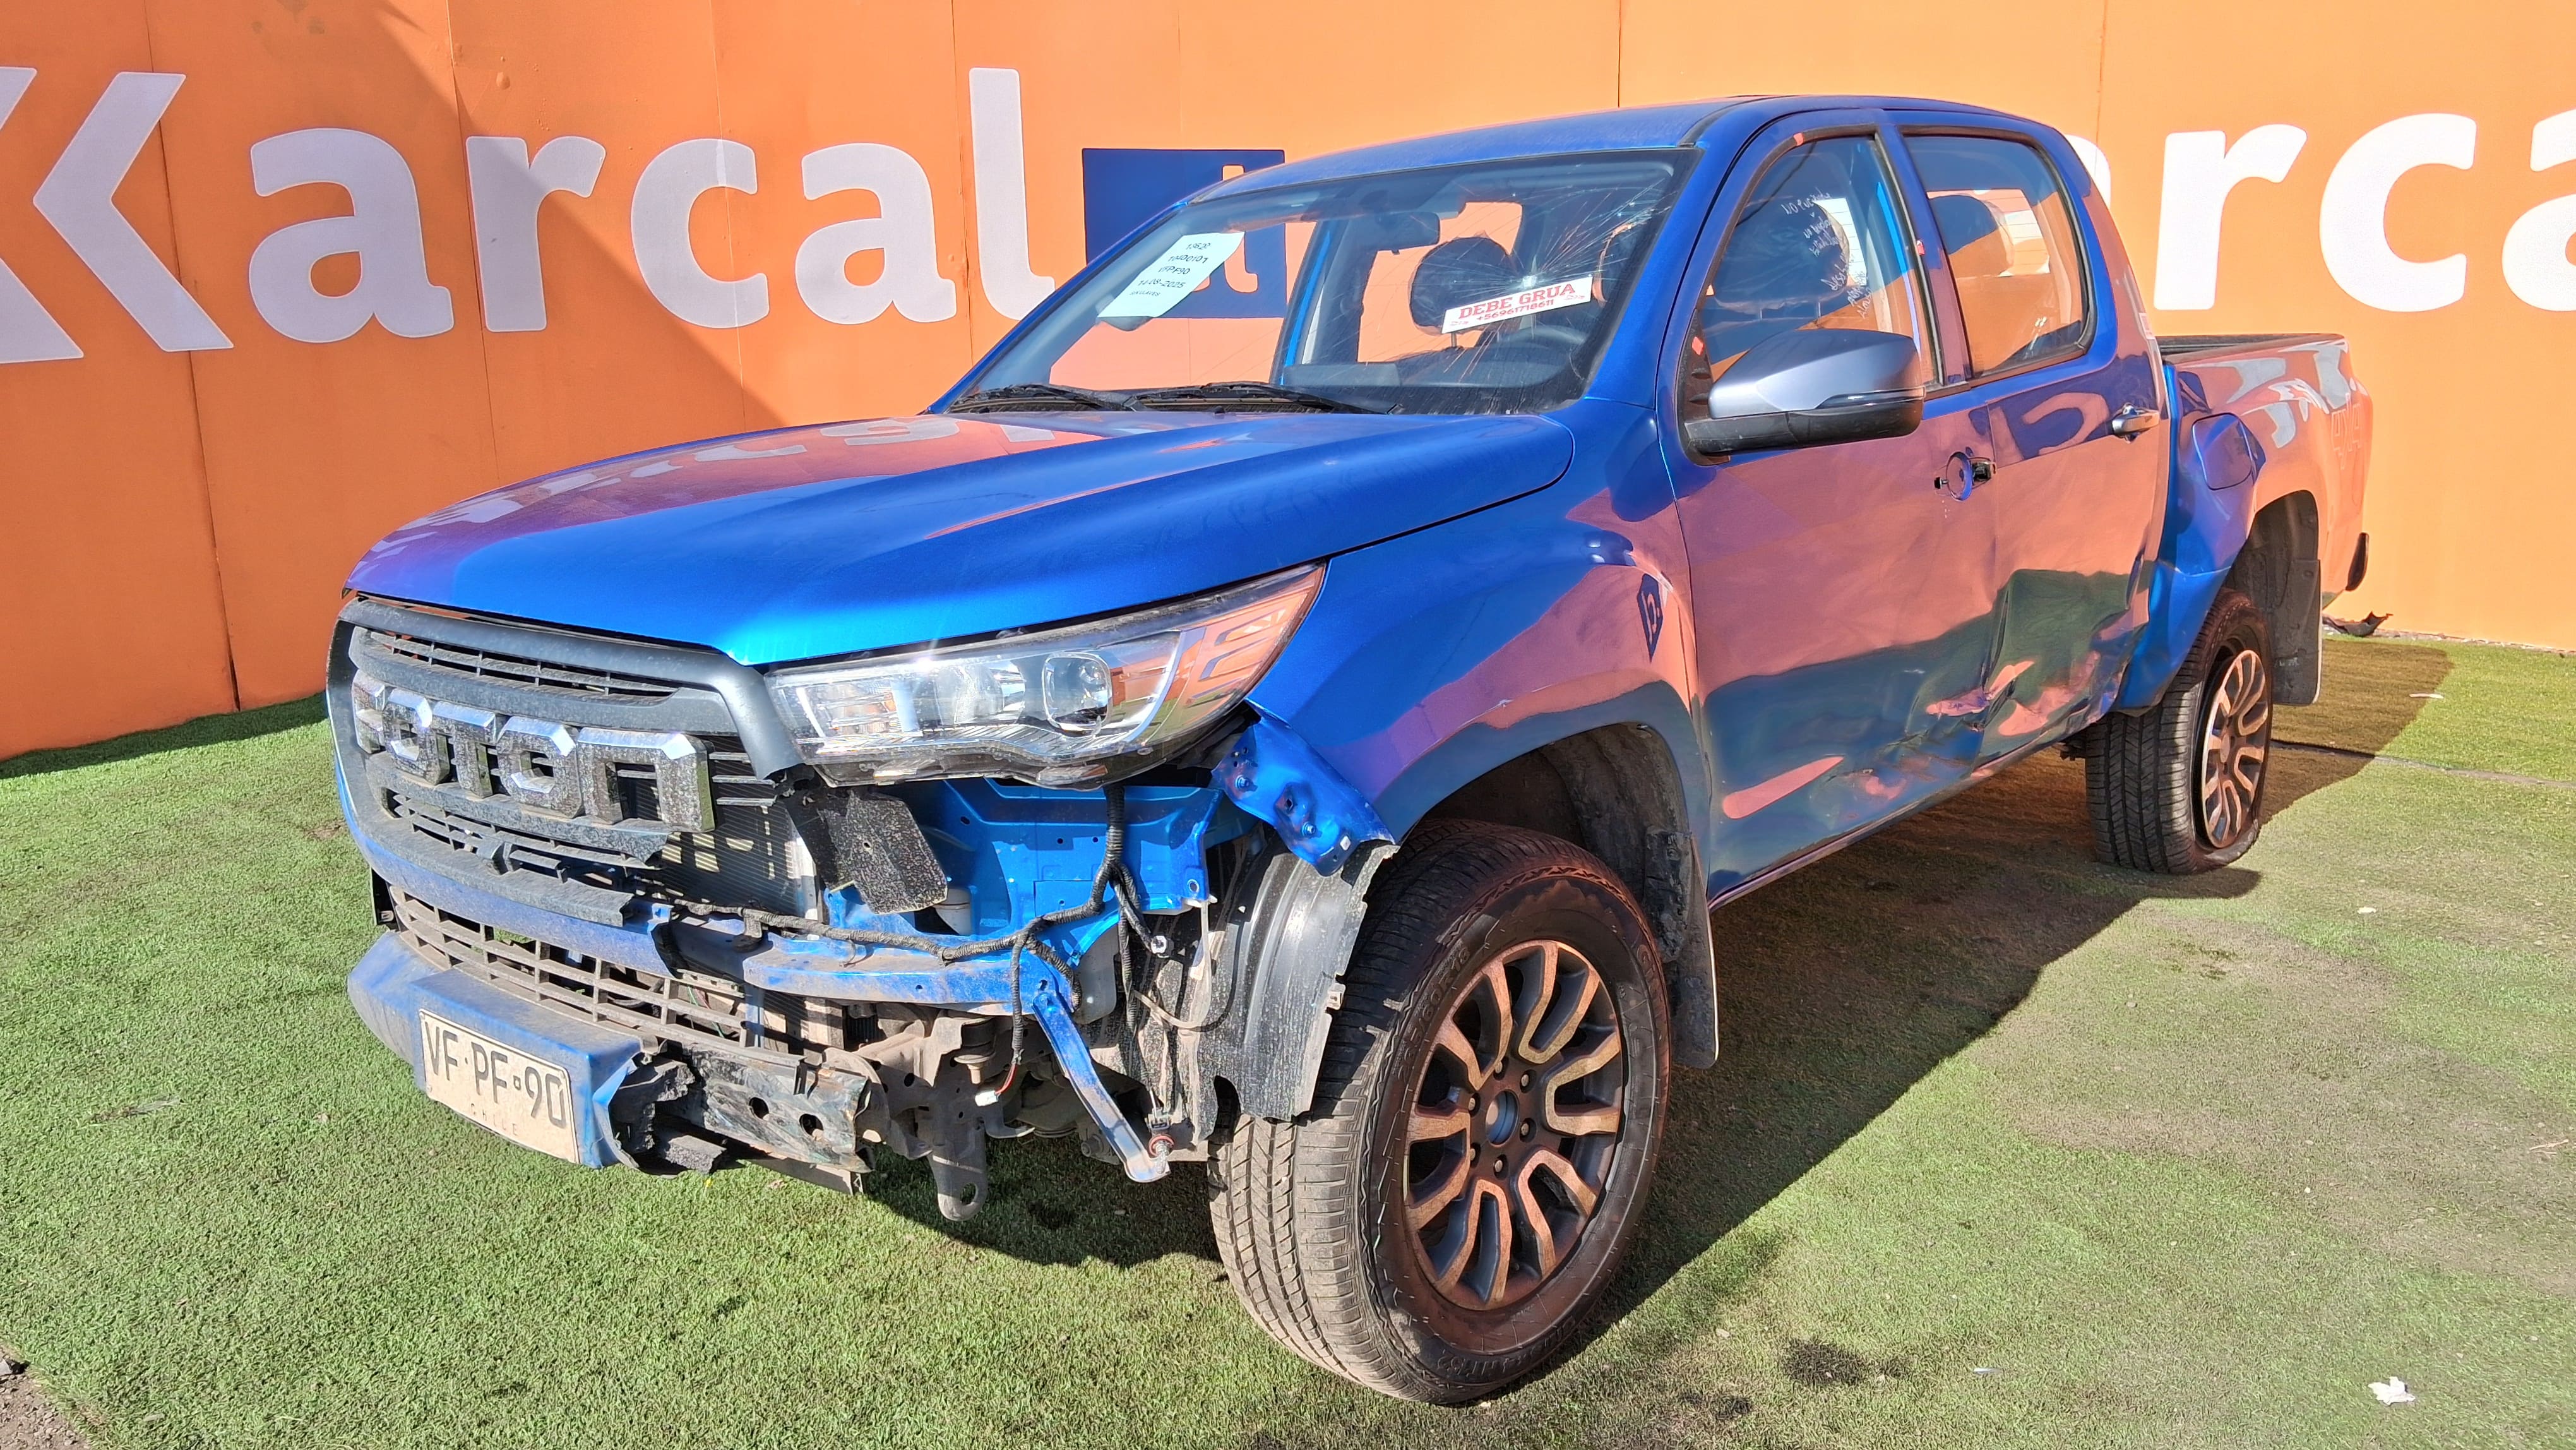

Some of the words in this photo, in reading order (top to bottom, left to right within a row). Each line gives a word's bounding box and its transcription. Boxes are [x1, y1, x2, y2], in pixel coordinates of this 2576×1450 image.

[1157, 266, 1191, 275] VFPF90
[1458, 297, 1513, 319] DEBE
[1519, 284, 1575, 304] GRUA
